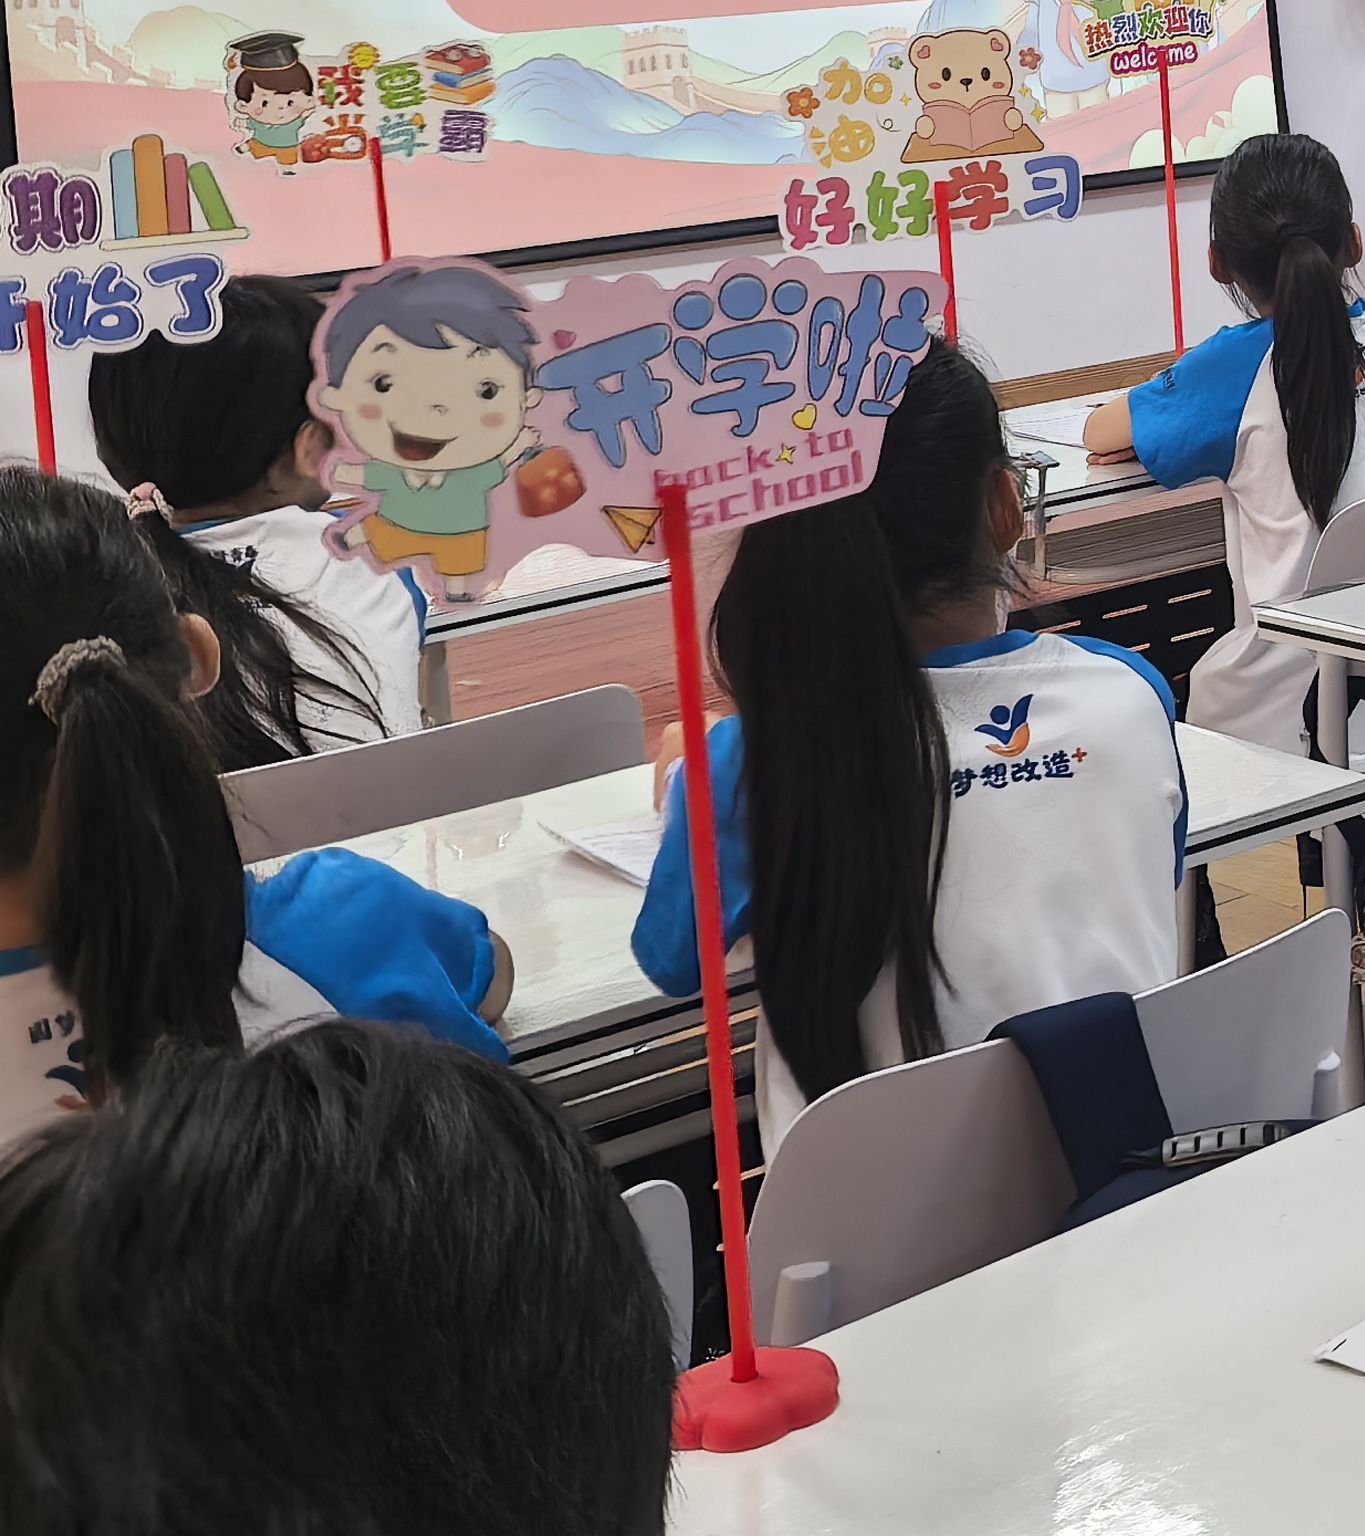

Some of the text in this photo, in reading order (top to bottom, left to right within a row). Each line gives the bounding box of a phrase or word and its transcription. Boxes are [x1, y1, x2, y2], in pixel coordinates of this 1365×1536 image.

[1085, 5, 1210, 54] 热烈欢迎你
[1112, 41, 1197, 71] welcme
[318, 62, 428, 110] 我要
[306, 110, 488, 161] 当学霸
[6, 170, 100, 252] 期
[784, 154, 1082, 251] 好好学习
[536, 272, 932, 469] 开学啦
[805, 427, 854, 458] to
[689, 450, 864, 530] school
